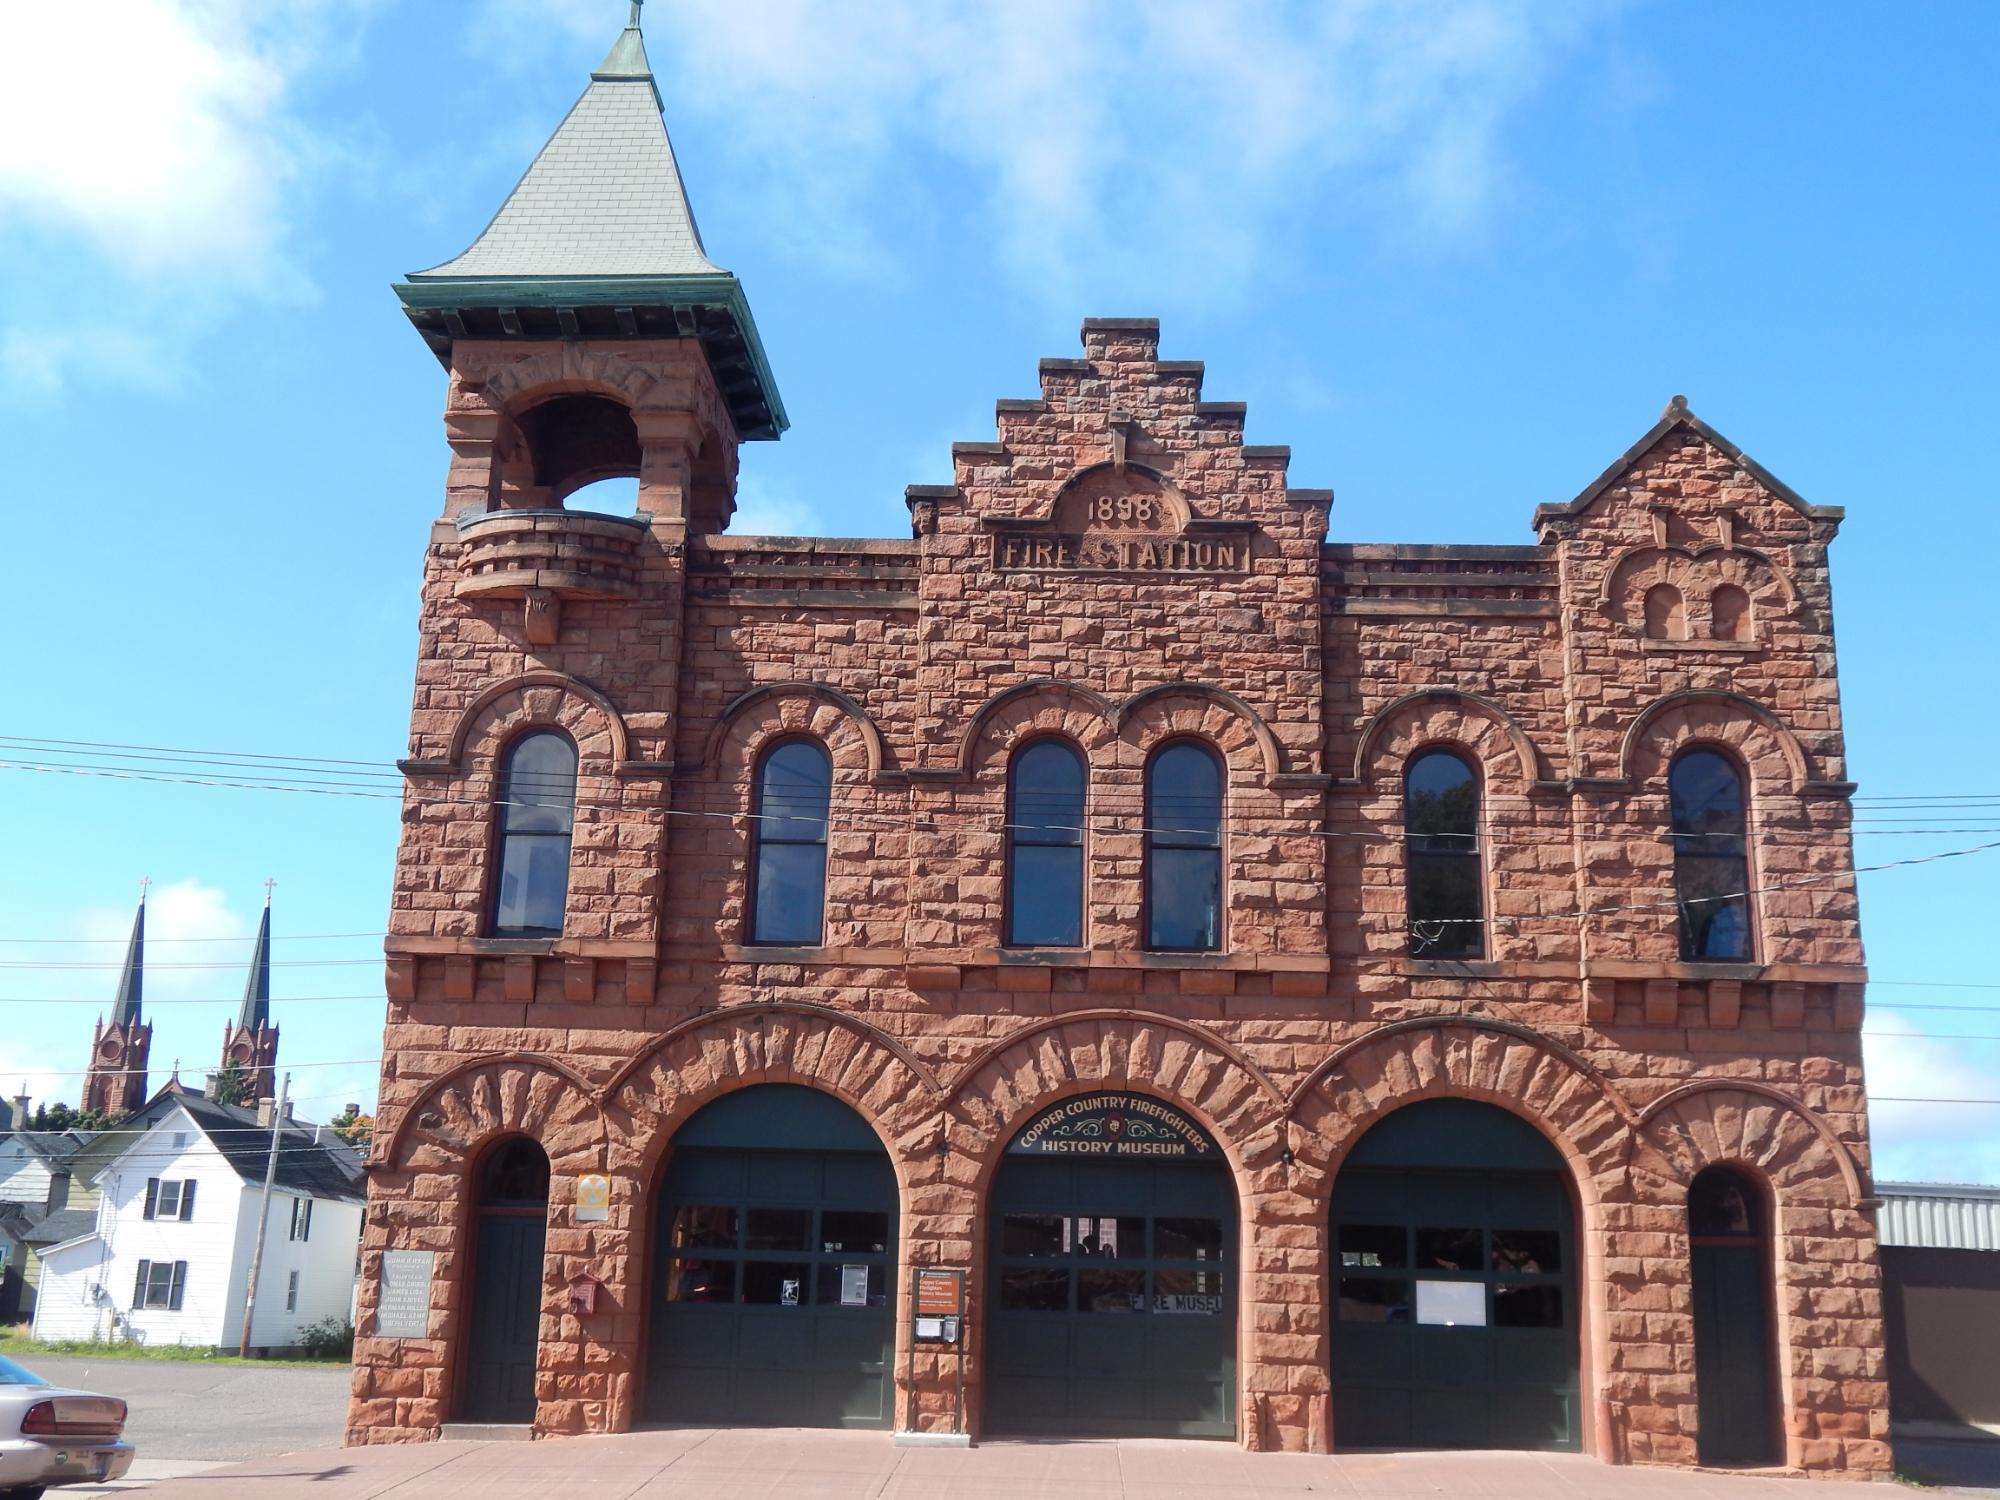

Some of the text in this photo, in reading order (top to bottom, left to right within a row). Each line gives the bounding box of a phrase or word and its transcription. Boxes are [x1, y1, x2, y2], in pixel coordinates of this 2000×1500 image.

[1088, 496, 1152, 522] 1898
[1005, 538, 1236, 567] FIRE STATION
[1020, 1096, 1209, 1153] COPPER COUNTRY FIREFIGHTERS
[1042, 1140, 1185, 1155] HISTORY MUSEUM
